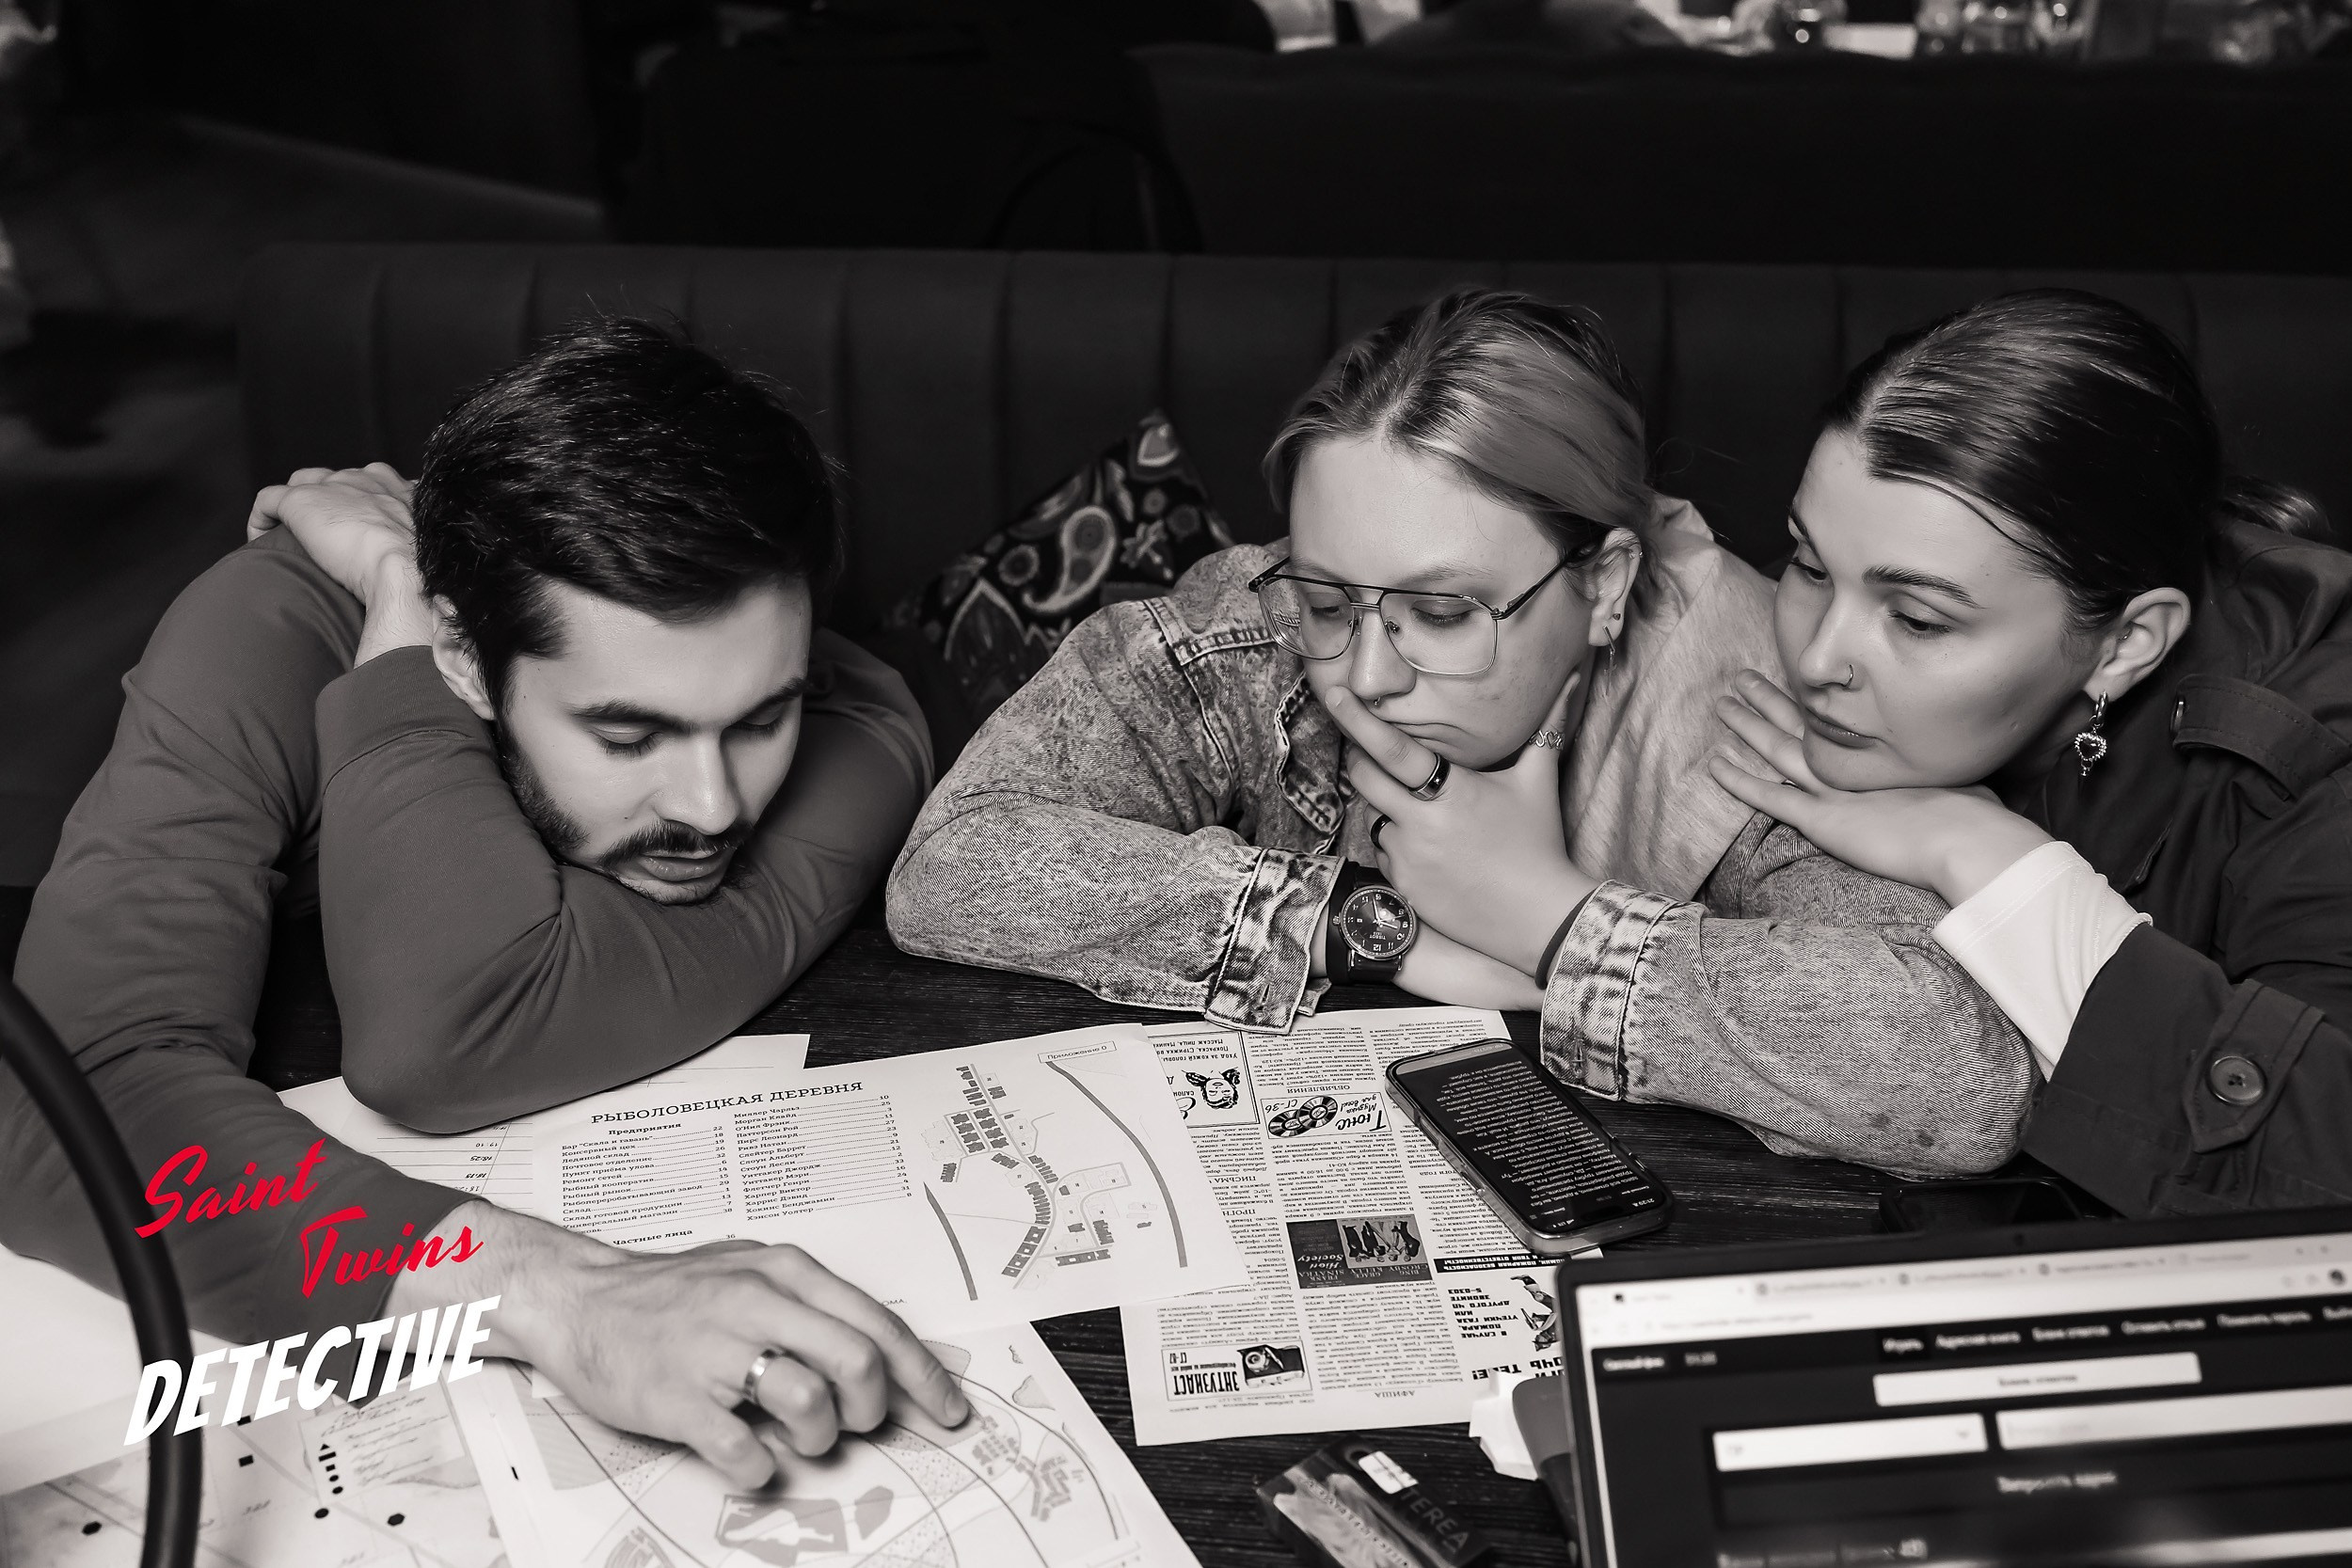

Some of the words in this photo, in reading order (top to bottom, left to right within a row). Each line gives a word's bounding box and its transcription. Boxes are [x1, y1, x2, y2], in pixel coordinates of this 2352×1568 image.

[1287, 1085, 1350, 1094] ОБЪЯВЛЕНИЯ
[591, 1094, 764, 1124] РЫБОЛОВЕЦКАЯ
[770, 1082, 864, 1102] ДЕРЕВНЯ
[1346, 1102, 1377, 1115] Музыка
[1335, 1110, 1387, 1132] Тюнс
[609, 1123, 681, 1135] Предприятия
[737, 1129, 781, 1138] Паттерсон
[761, 1132, 799, 1141] Леонард
[562, 1147, 617, 1157] Консервный
[769, 1152, 804, 1161] Альберт
[562, 1155, 601, 1164] Ледяной
[605, 1157, 652, 1165] отделение
[741, 1169, 783, 1179] Уиттакер
[785, 1164, 820, 1173] Джордж
[602, 1179, 654, 1187] кооператив
[742, 1177, 784, 1185] Уиттакер
[602, 1188, 631, 1196] рынок
[743, 1184, 781, 1193] Флетчер
[563, 1189, 675, 1207] Рыбоперерабатывающий
[780, 1194, 808, 1202] Дэвид
[746, 1205, 779, 1213] Хокинс
[782, 1197, 834, 1208] Бенджамин
[594, 1210, 628, 1218] готовой
[631, 1202, 682, 1213] продукции
[563, 1215, 637, 1231] Универсальный
[640, 1210, 677, 1219] магазин
[612, 1235, 661, 1245] Частные
[1296, 1254, 1343, 1262] Society
[1389, 1263, 1428, 1272] CROSBY
[1469, 1300, 1510, 1308] ДРУГОГО
[1484, 1314, 1519, 1323] УТЕЧКИ
[1375, 1389, 1415, 1399] АФИША
[1401, 1486, 1470, 1555] TEREA
